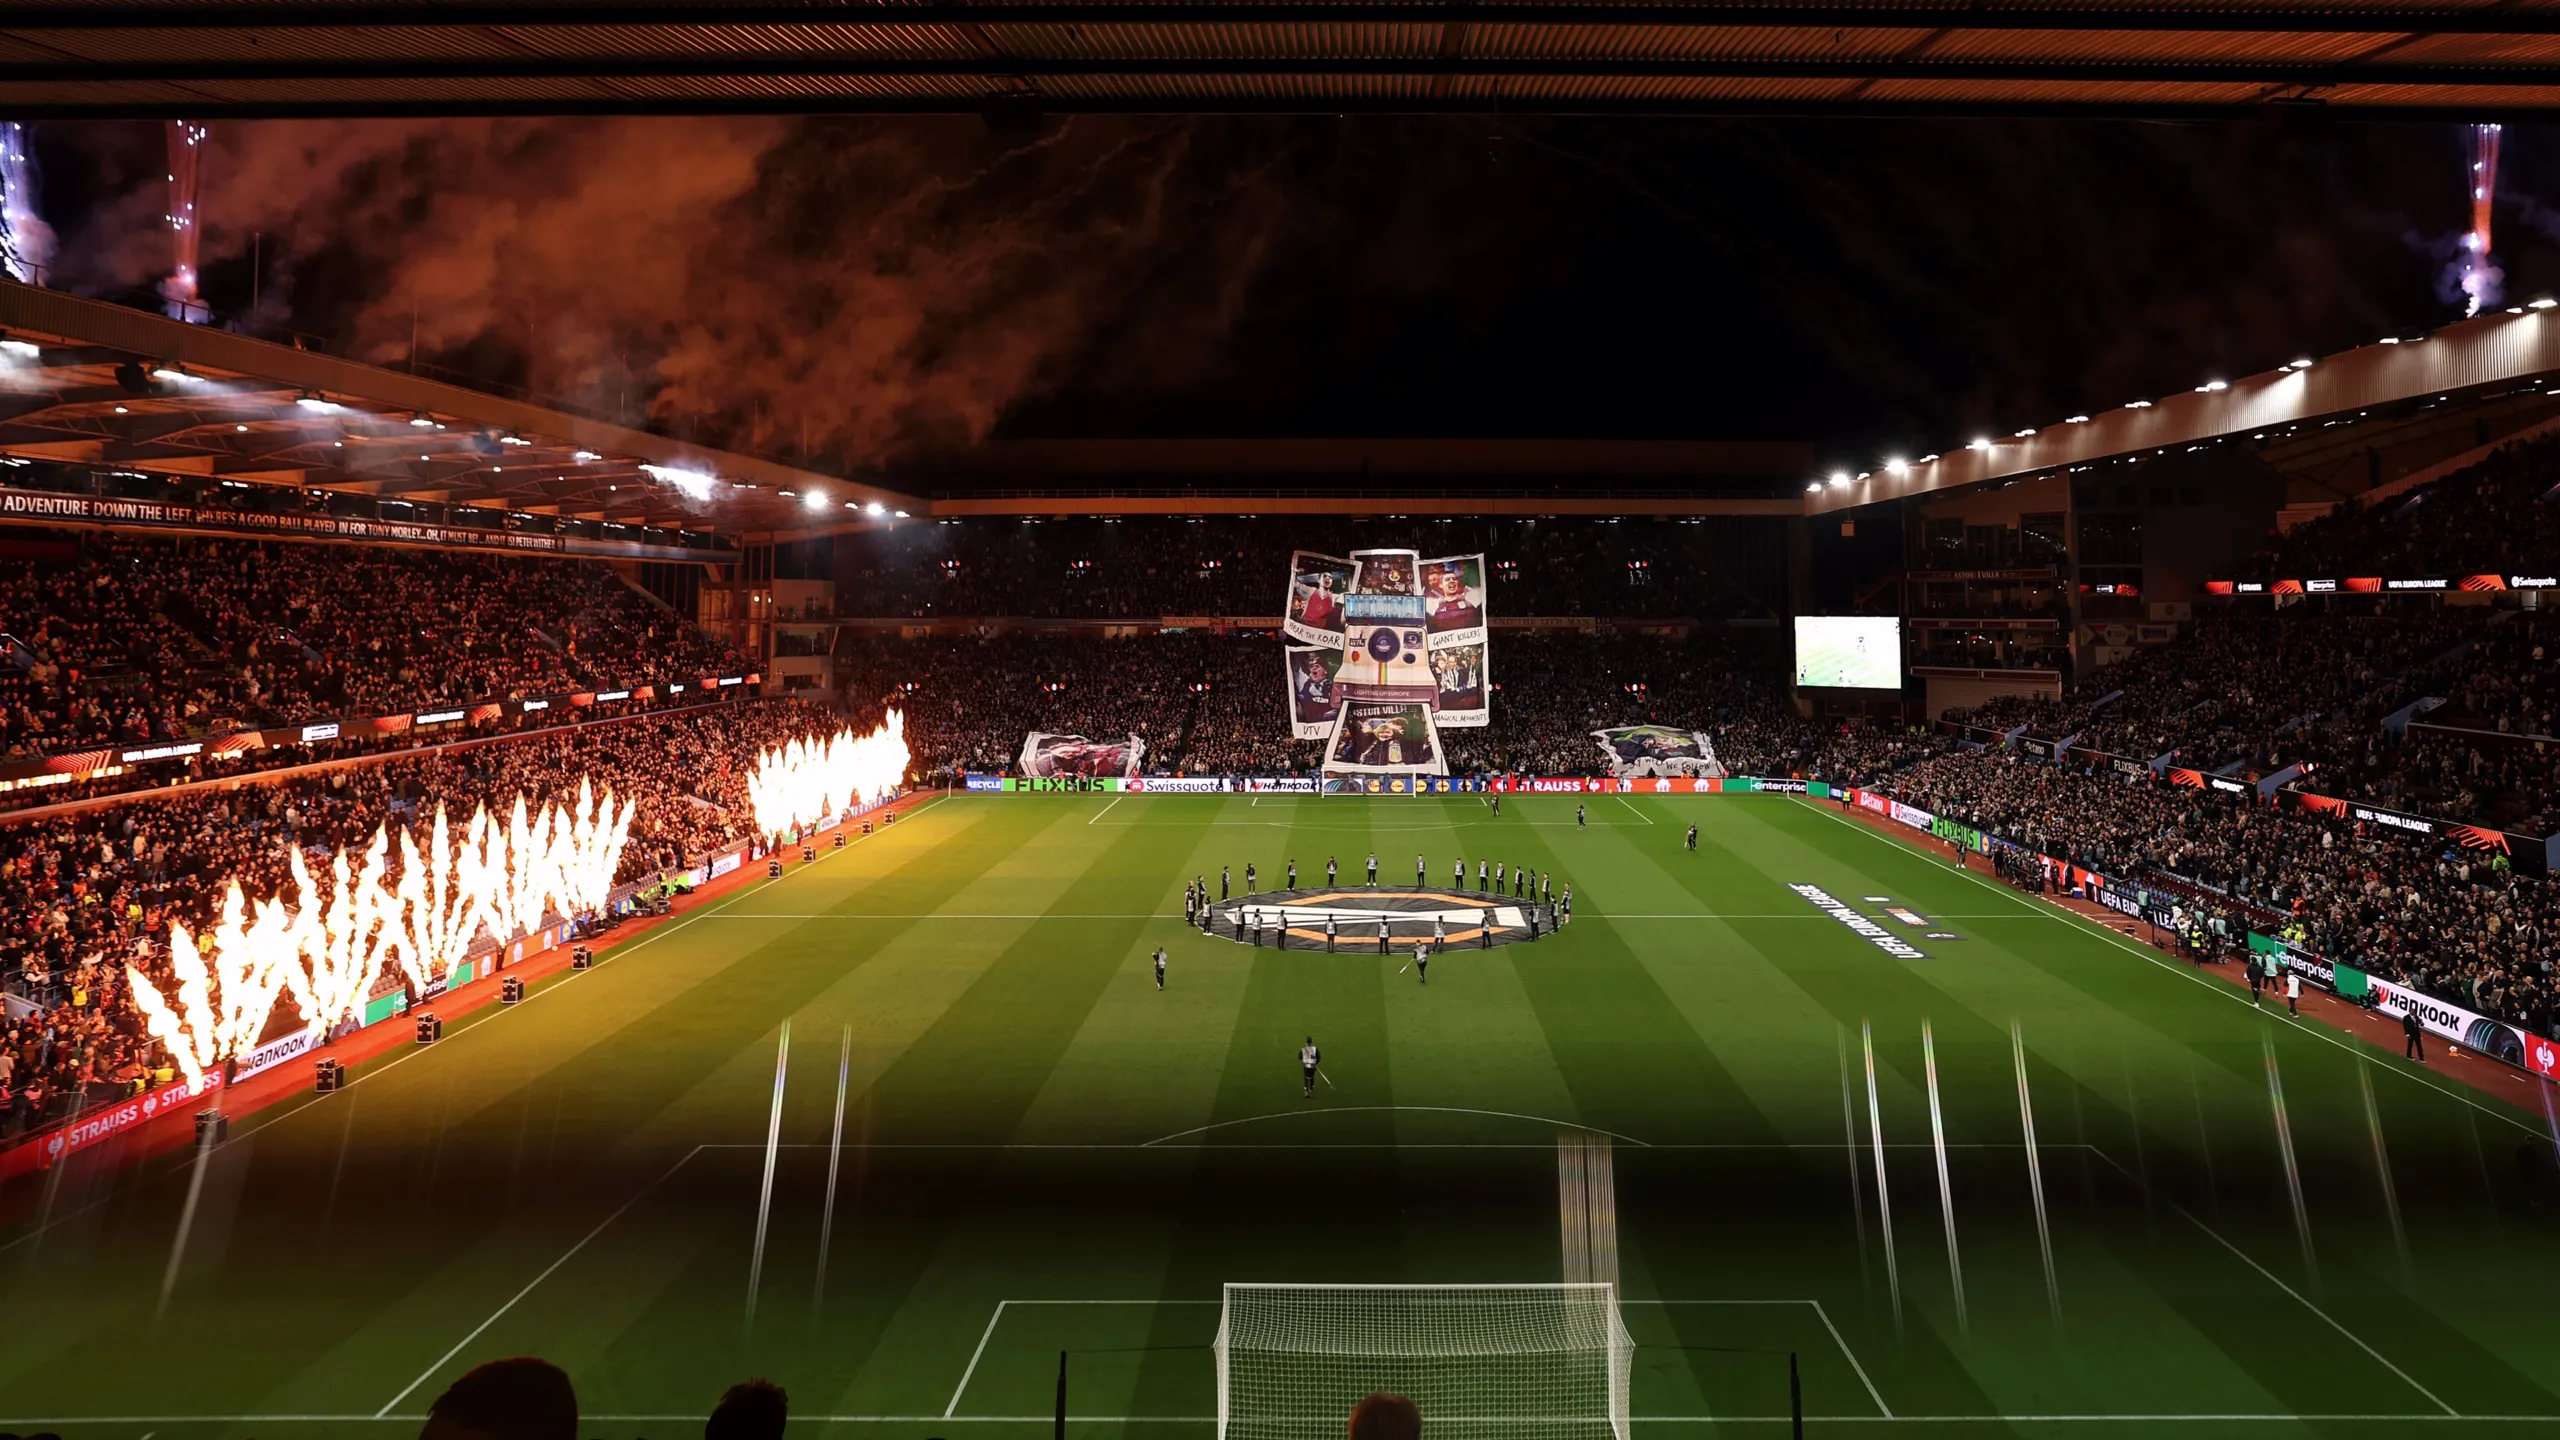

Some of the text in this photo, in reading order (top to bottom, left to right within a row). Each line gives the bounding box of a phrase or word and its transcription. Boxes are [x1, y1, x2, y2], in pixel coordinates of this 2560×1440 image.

[4, 495, 89, 515] ADVENTURE
[93, 501, 136, 518] DOWN
[139, 505, 162, 520] THE
[247, 514, 277, 528] GOOD
[280, 516, 302, 530] BALL
[304, 519, 336, 533] PLAYED
[338, 521, 349, 534] IN
[350, 522, 366, 536] FOR
[367, 524, 390, 537] TONY
[448, 531, 467, 543] MUST
[1954, 571, 1975, 579] ASTON
[2519, 577, 2557, 588] Swissquote
[1289, 622, 1304, 637] HEAR
[1306, 632, 1316, 640] THE
[1317, 635, 1340, 647] ROAR
[1433, 629, 1480, 647] GIANT KILLERS
[1434, 713, 1458, 722] MAGICAL
[1303, 725, 1320, 736] UTV
[967, 780, 1001, 790] RECYCLE
[1752, 782, 1806, 792] enterprise
[1860, 791, 1884, 812] Betano
[2101, 889, 2122, 911] UEFA
[2277, 949, 2334, 983] enterprise
[161, 1070, 221, 1107] STRSS
[70, 1104, 138, 1147] STRAUSS
